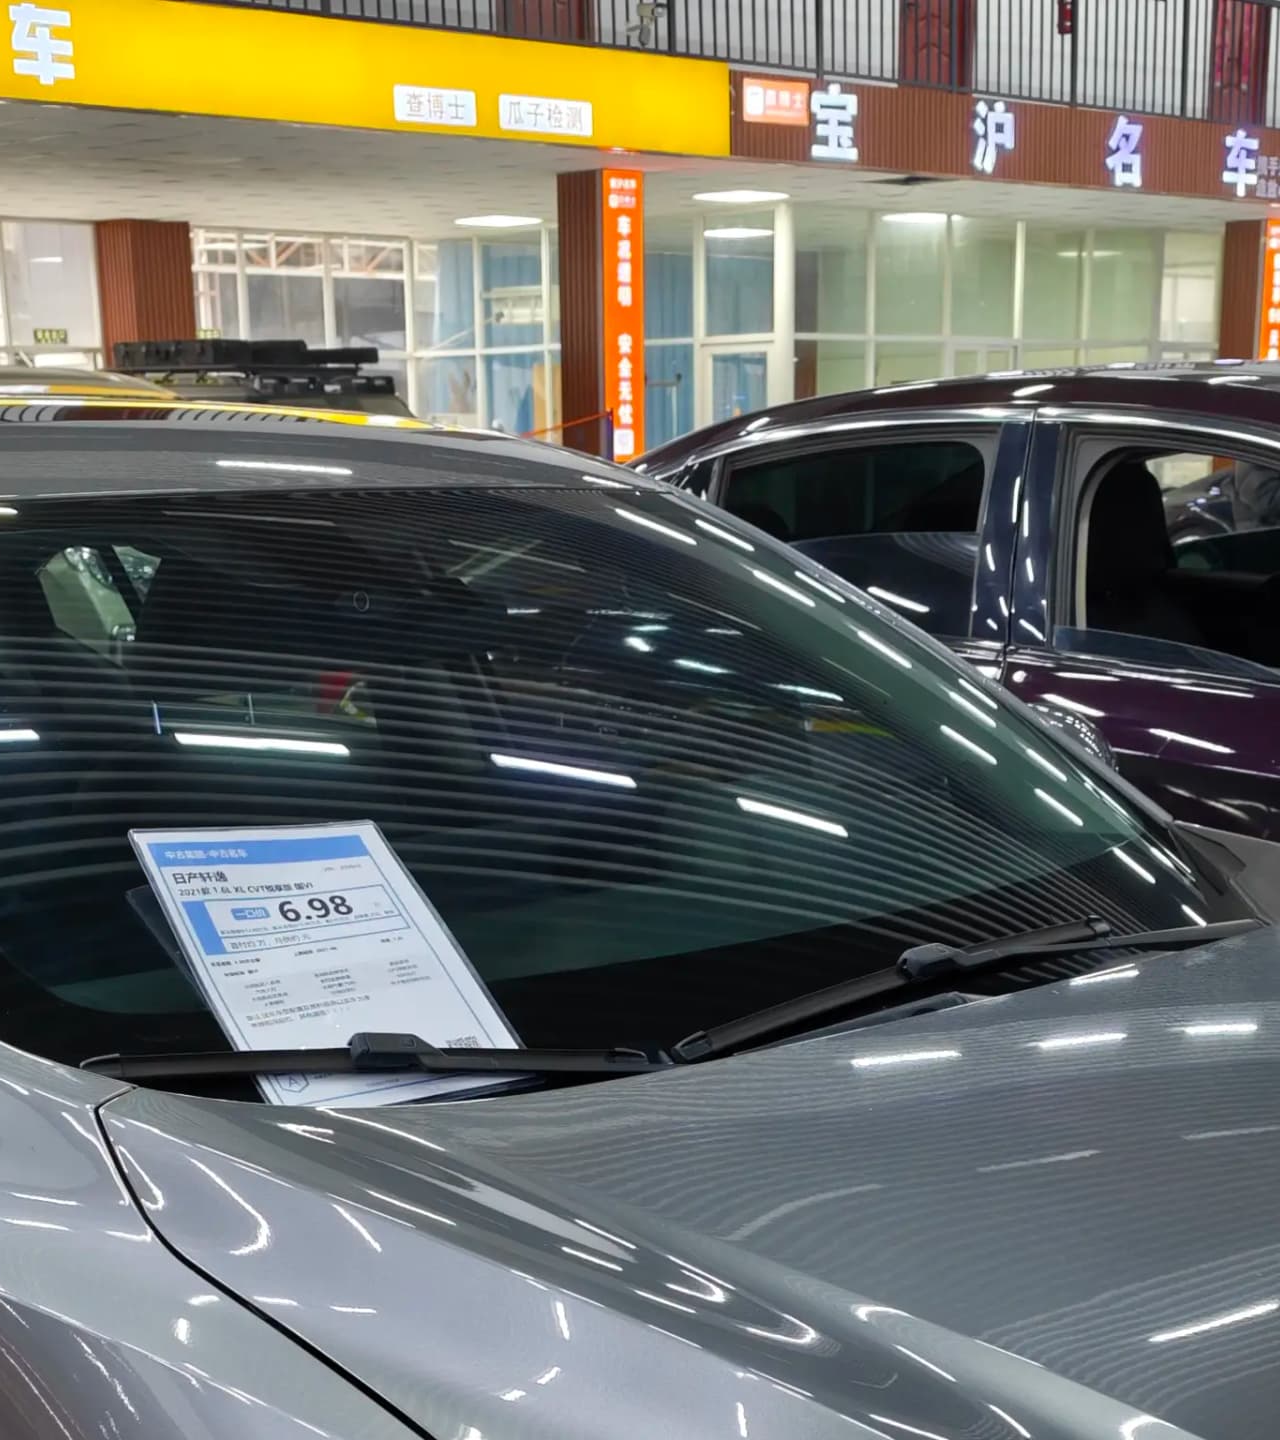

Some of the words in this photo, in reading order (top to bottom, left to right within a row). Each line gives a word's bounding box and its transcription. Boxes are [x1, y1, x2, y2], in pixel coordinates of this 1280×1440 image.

[405, 92, 467, 122] 查博士
[507, 101, 585, 132] 瓜子检测
[810, 84, 1261, 198] 宝沪名车
[173, 870, 229, 885] 日产轩逸
[278, 894, 355, 923] 6.98
